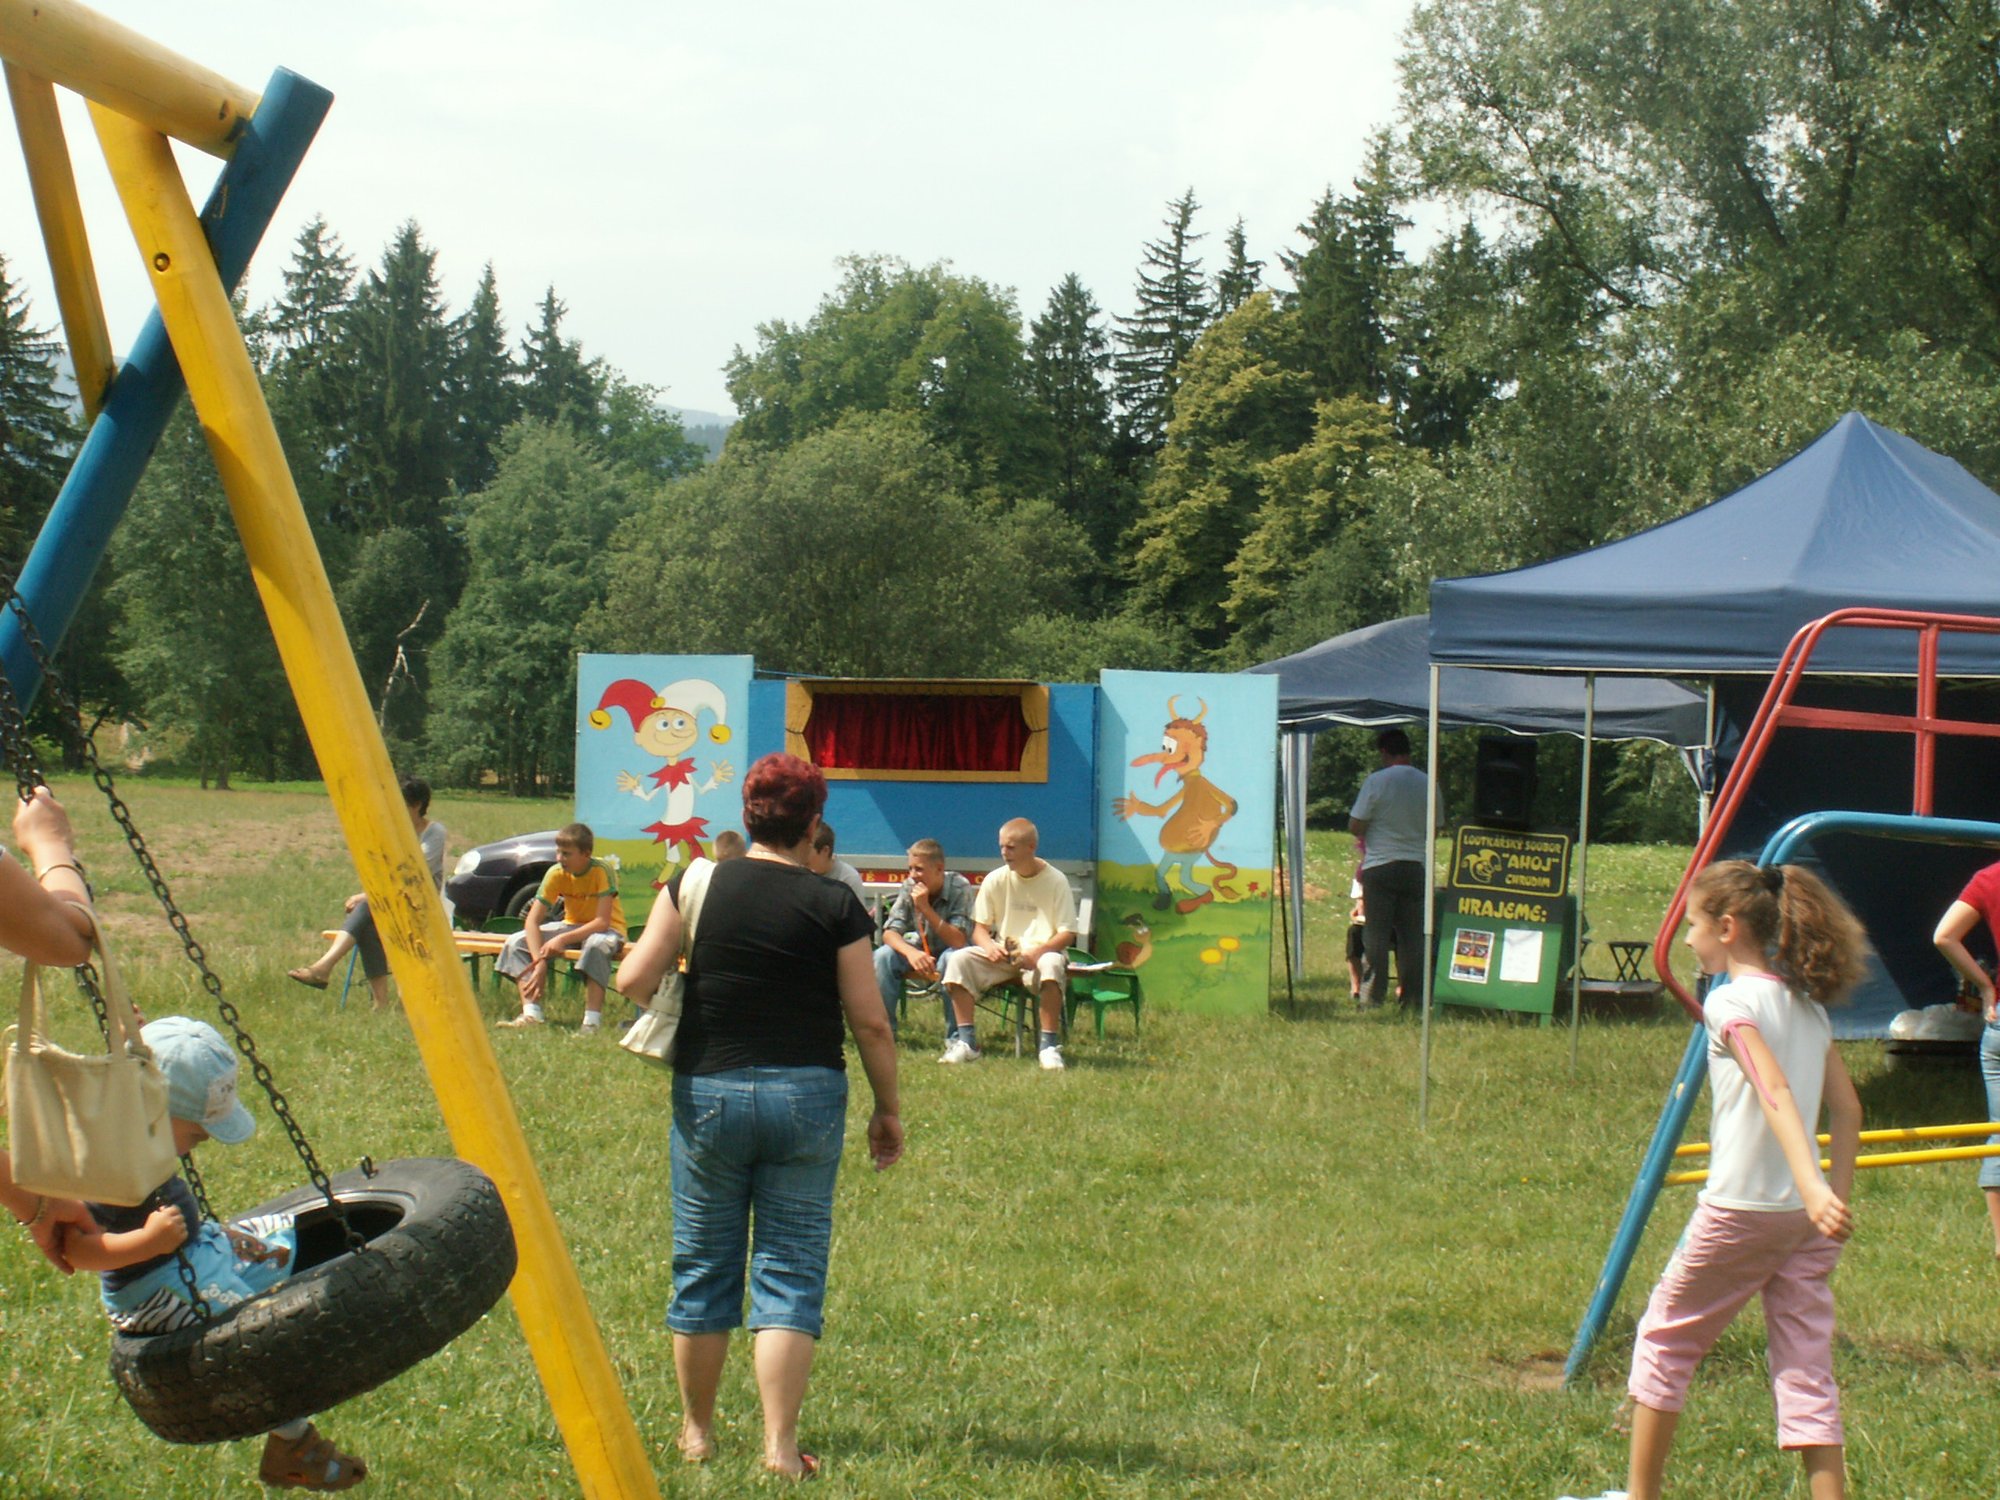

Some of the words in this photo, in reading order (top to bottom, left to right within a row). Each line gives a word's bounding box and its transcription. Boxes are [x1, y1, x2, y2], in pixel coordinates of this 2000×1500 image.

[1525, 840, 1562, 853] SOUBOR
[1505, 873, 1551, 888] CHRUDIM
[1458, 897, 1548, 923] HRAJEME:
